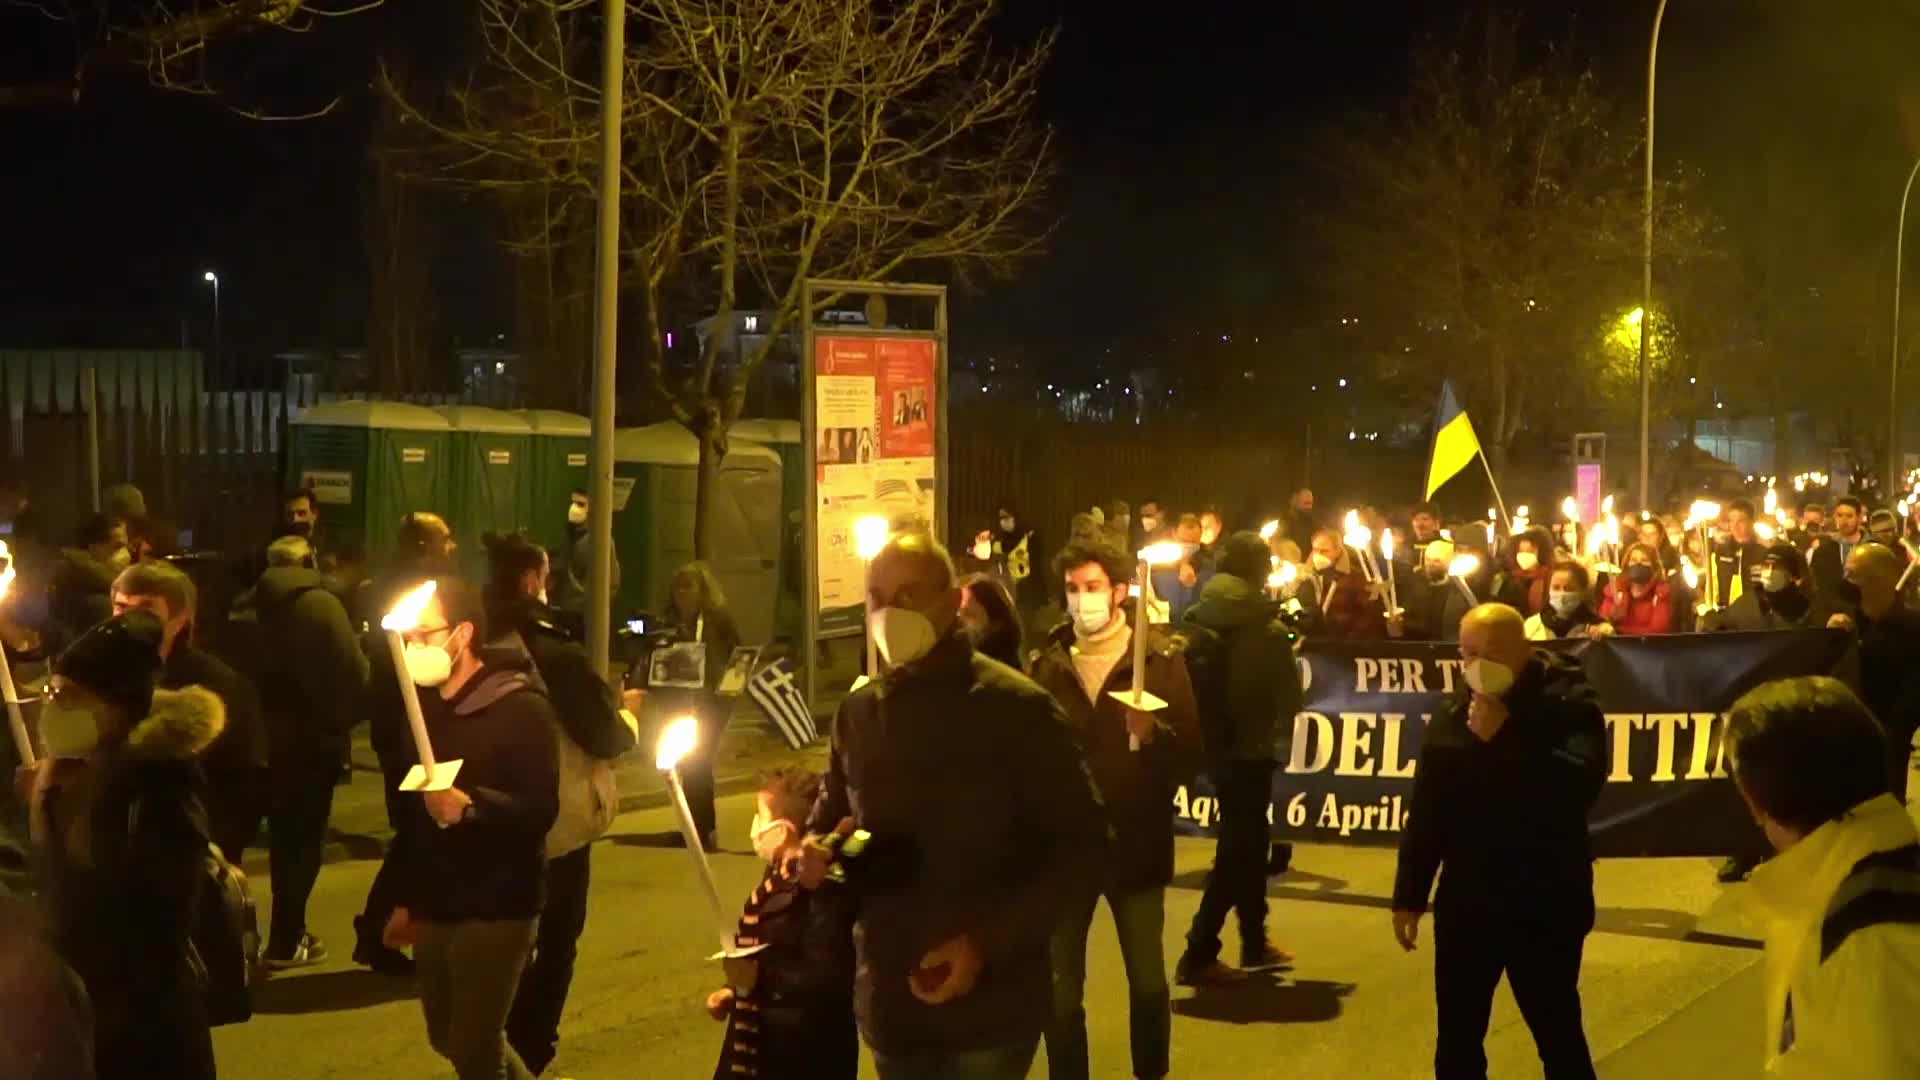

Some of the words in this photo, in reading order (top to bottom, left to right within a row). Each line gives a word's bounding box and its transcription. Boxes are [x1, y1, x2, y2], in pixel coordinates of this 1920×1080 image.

[1355, 657, 1427, 693] PER
[1435, 659, 1466, 693] T
[1284, 711, 1432, 778] DEL
[1603, 712, 1730, 783] TTI
[1287, 791, 1307, 827] 6
